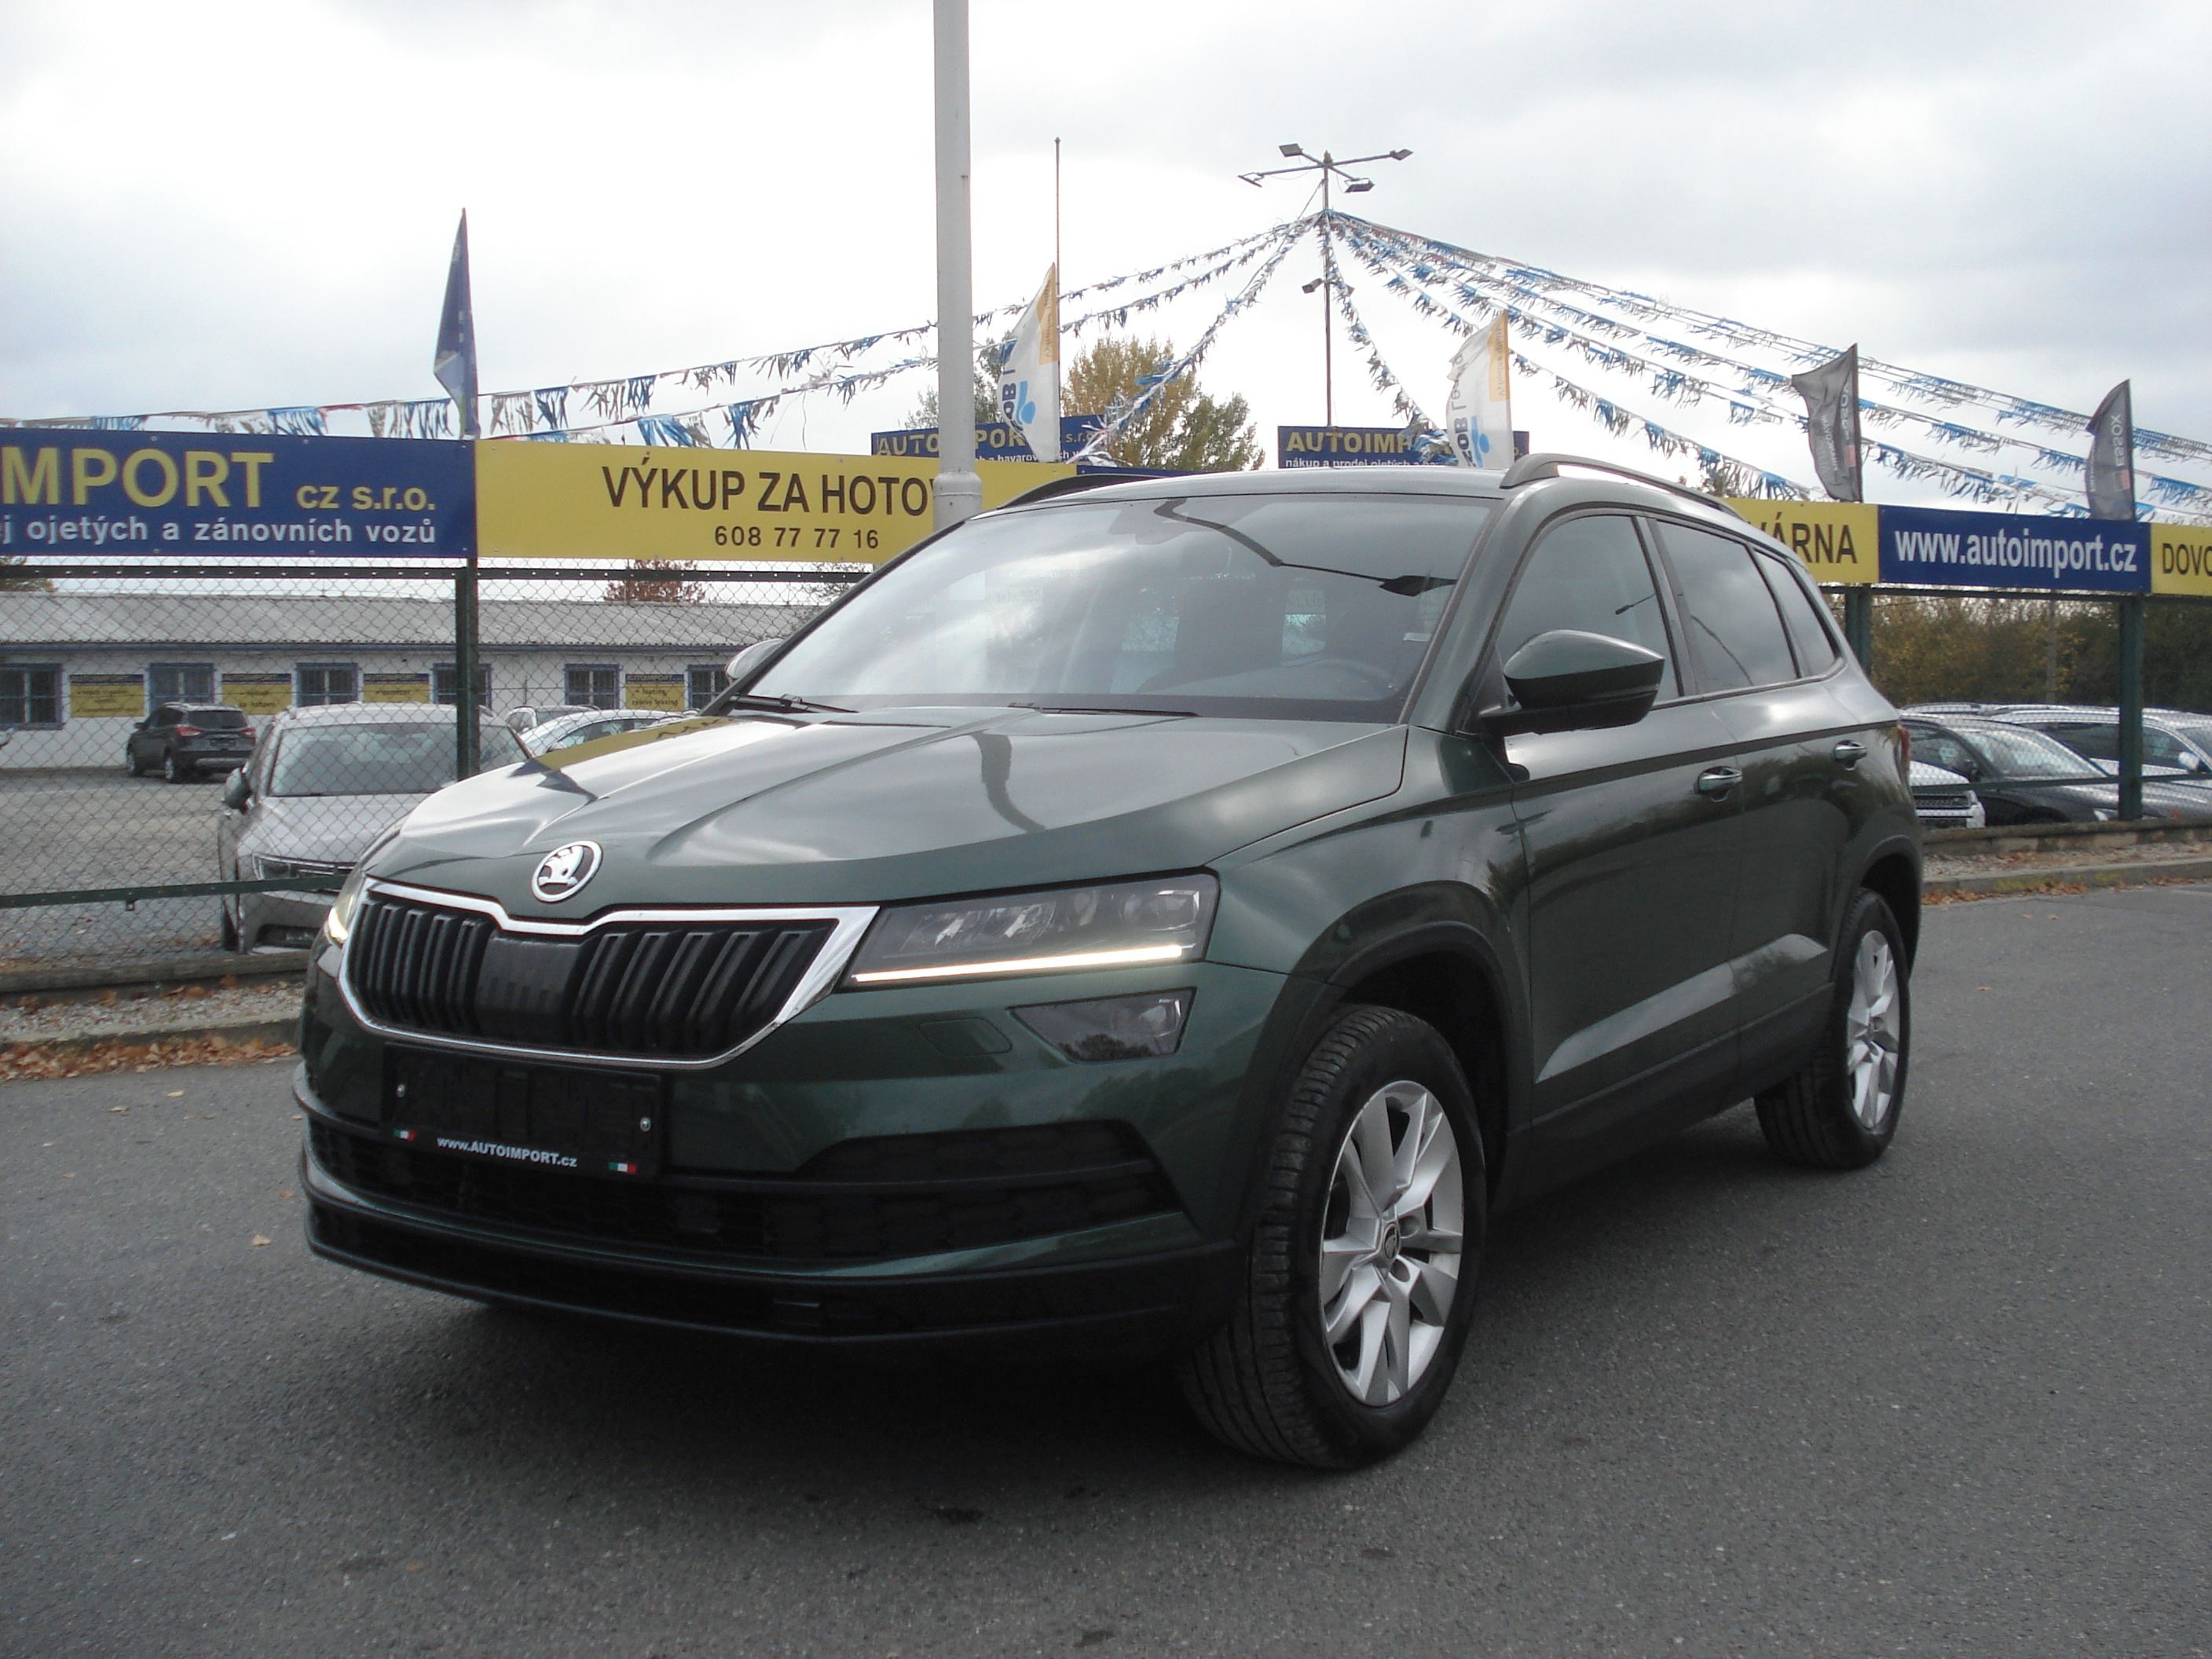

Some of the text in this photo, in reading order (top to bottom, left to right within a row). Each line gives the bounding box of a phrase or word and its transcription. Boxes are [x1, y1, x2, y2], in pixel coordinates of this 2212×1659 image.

[296, 485, 340, 509] cz
[352, 485, 436, 511] s.r.o.
[602, 457, 934, 517] VÝKUP ZA HOTO
[27, 515, 148, 545] ojetých
[162, 522, 180, 540] a
[195, 517, 352, 542] zánovních
[365, 518, 436, 543] vozů
[714, 526, 880, 549] 608 77 77 16
[1895, 528, 2137, 579] www.autoimport.cz
[436, 1137, 578, 1168] www.AUTOIMPORT.cz
